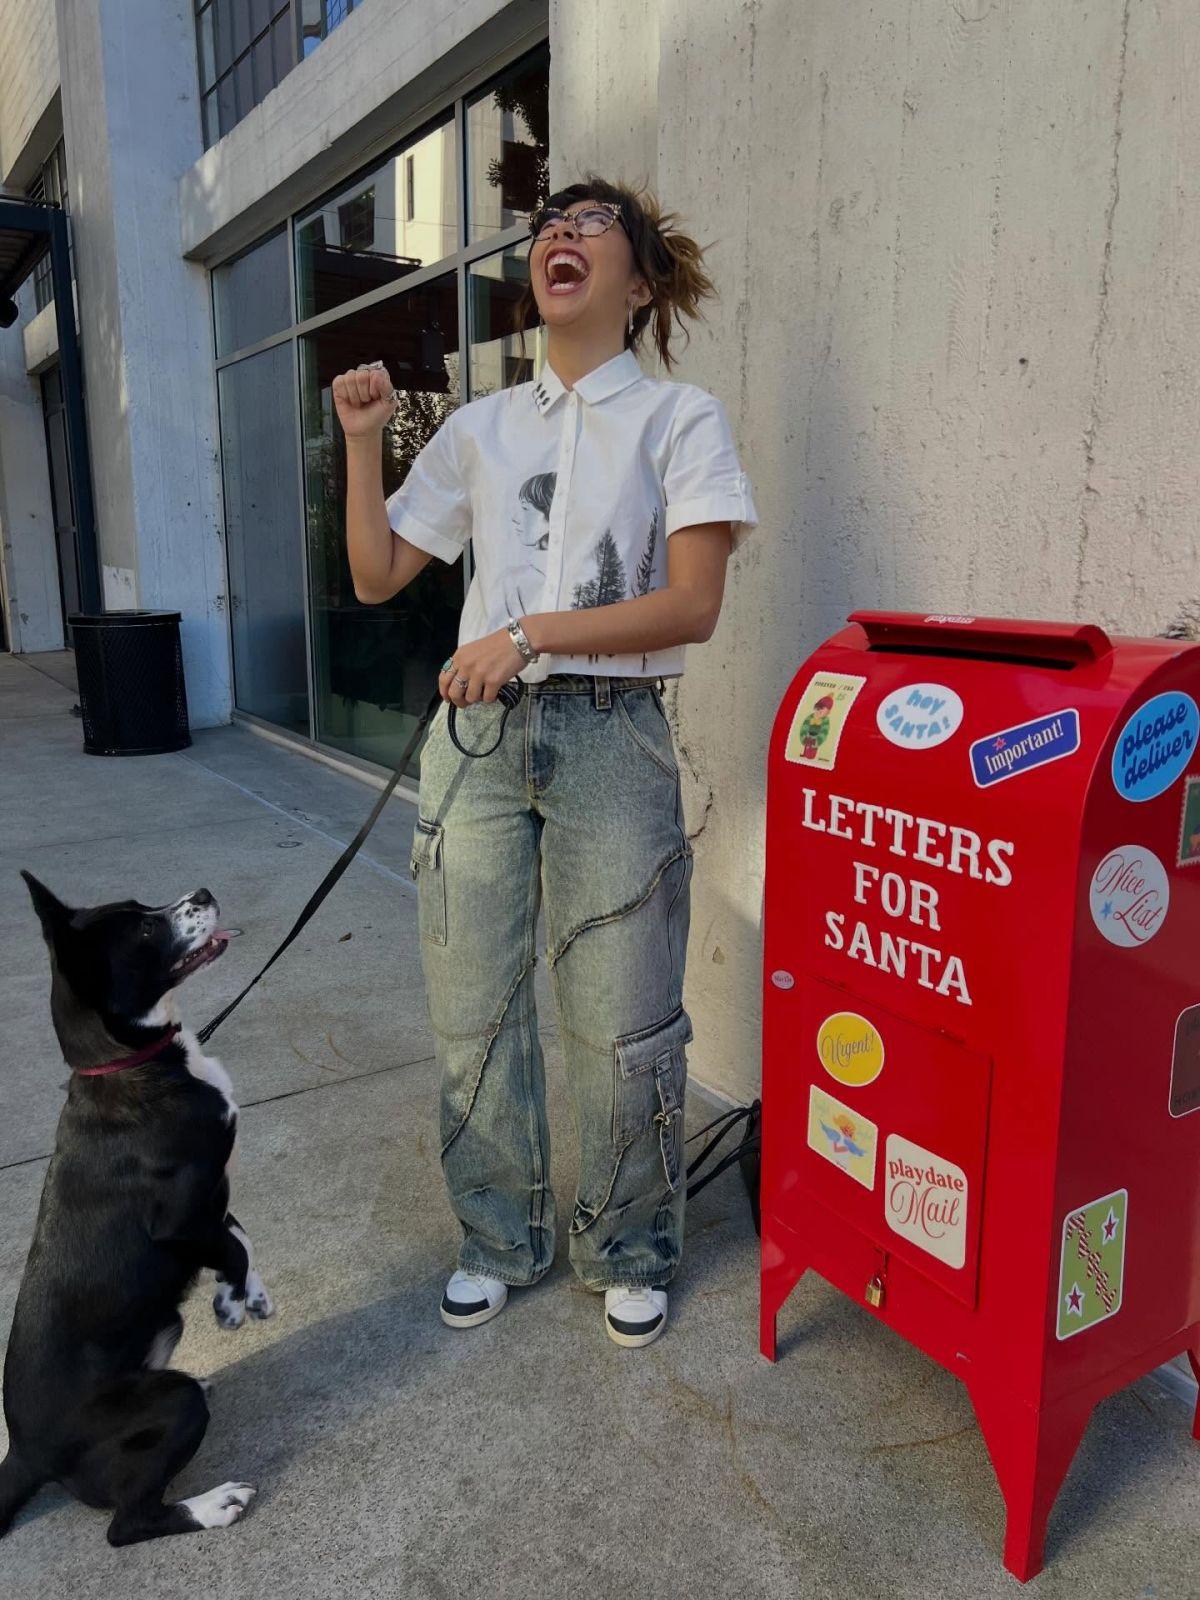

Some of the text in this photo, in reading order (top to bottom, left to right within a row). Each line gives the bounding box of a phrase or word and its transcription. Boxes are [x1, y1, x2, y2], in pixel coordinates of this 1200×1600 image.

[984, 719, 1064, 775] Important!
[1122, 702, 1188, 767] please
[1124, 729, 1194, 789] deliver
[801, 787, 1015, 887] LETTERS
[853, 861, 941, 931] FOR
[1095, 854, 1144, 896] Nice
[1113, 890, 1163, 942] List
[825, 911, 973, 1006] SANTA
[821, 1031, 875, 1068] Urgent!
[888, 1158, 964, 1192] playdate
[889, 1180, 960, 1239] Mail
